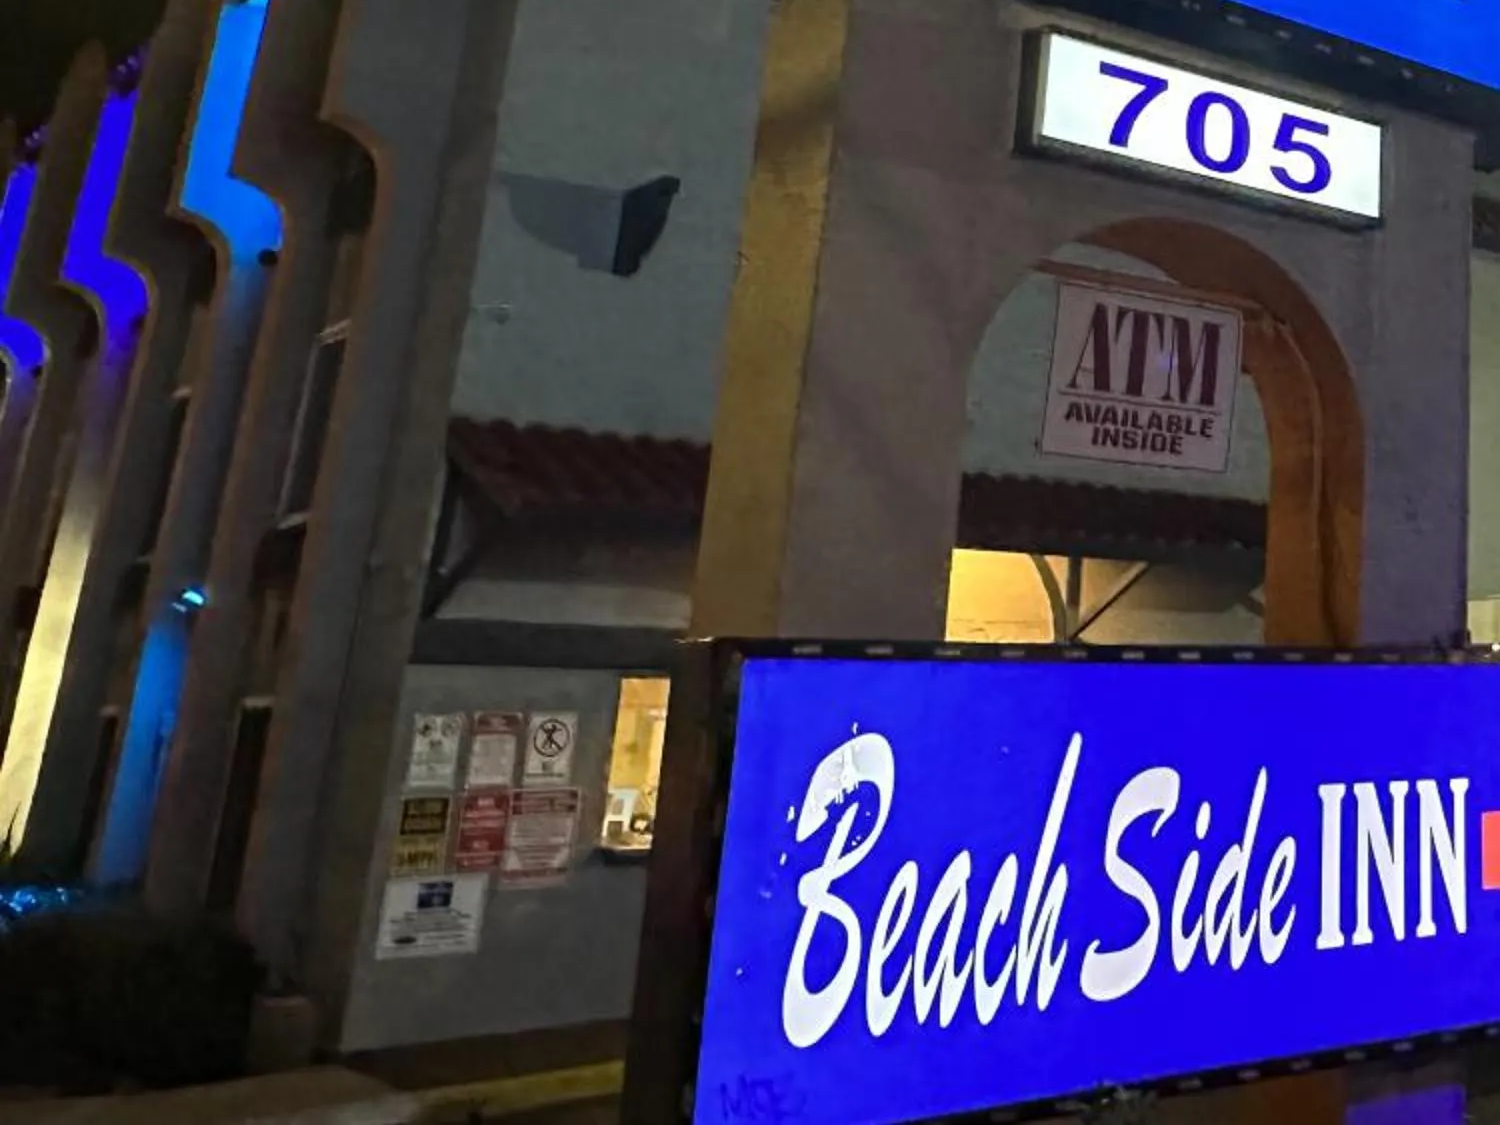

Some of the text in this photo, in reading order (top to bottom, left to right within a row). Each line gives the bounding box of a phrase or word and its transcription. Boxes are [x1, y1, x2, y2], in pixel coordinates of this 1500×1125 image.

[1099, 60, 1332, 194] 705
[1066, 302, 1223, 406] ATM
[1064, 400, 1215, 439] AVAILABLE
[1090, 426, 1184, 456] INSIDE
[1316, 777, 1470, 950] INN
